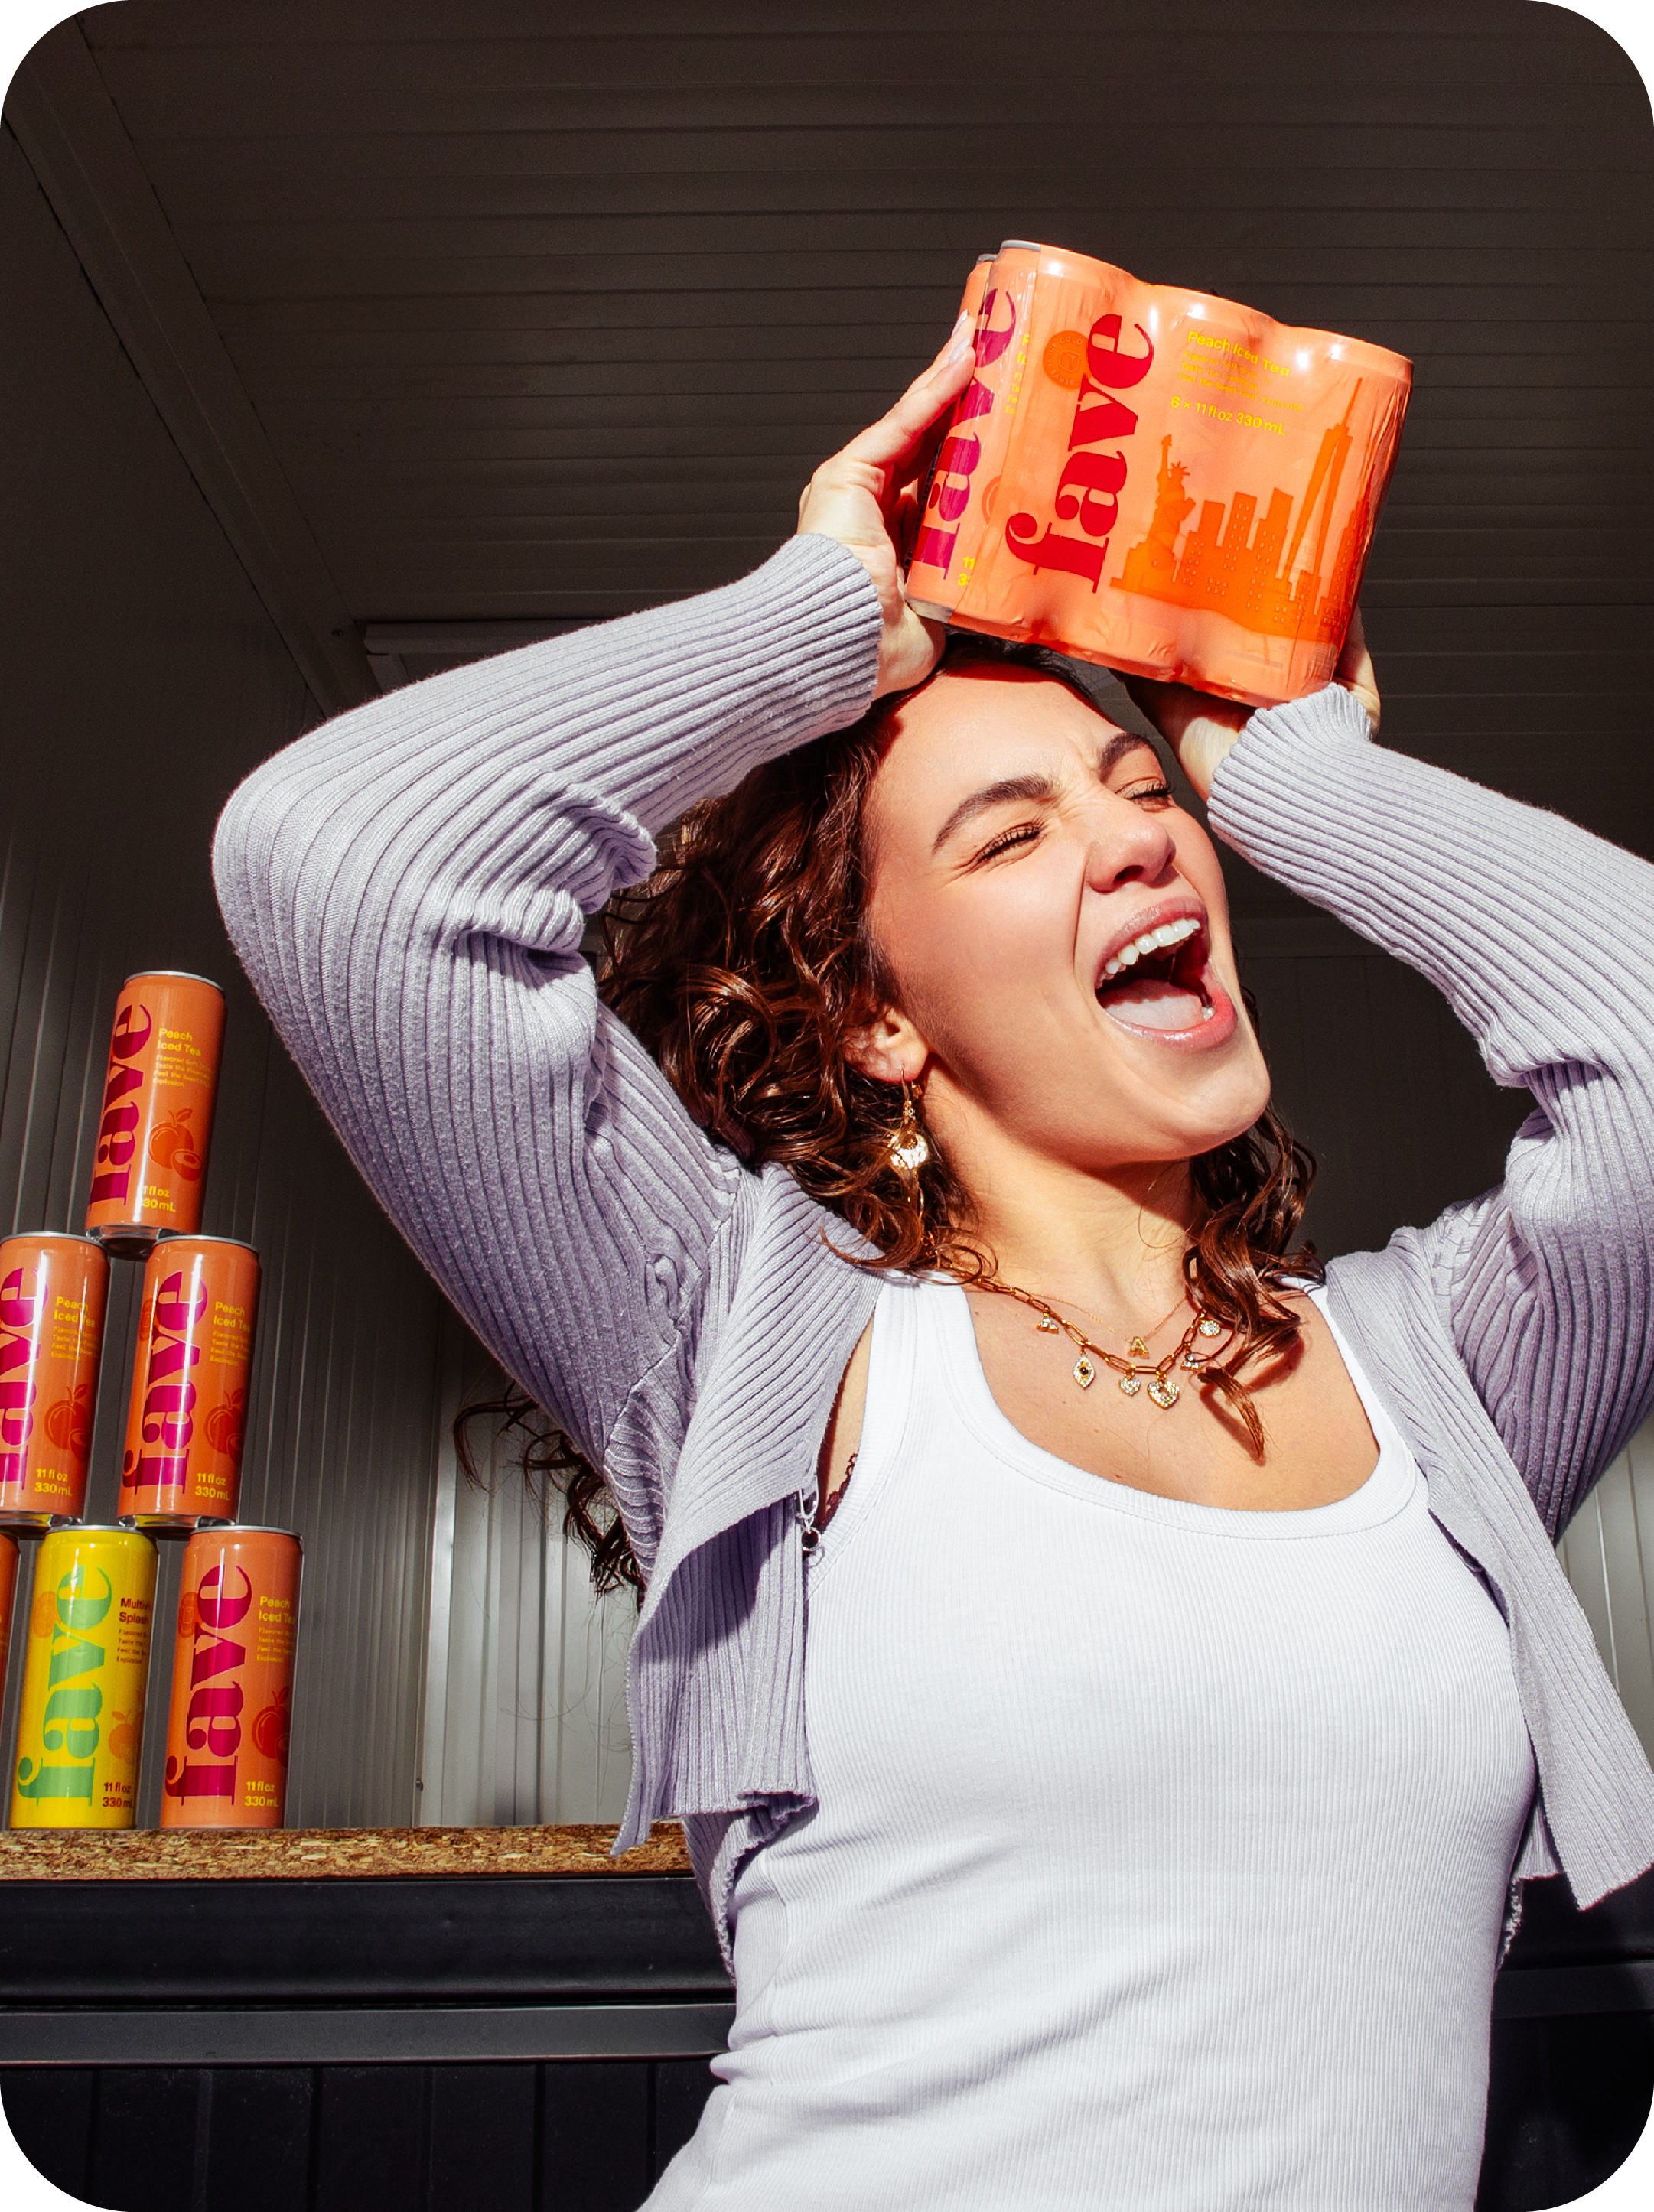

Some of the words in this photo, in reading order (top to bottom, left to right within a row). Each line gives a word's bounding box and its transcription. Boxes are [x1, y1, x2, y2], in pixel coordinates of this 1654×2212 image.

[1187, 331, 1230, 353] Peach
[1233, 343, 1259, 365] Iced
[1263, 359, 1290, 376] Tea
[1170, 395, 1180, 409] 6
[1236, 412, 1262, 428] 330
[1264, 421, 1286, 436] mL
[1005, 314, 1154, 594] fave
[158, 1028, 192, 1041] Peach
[158, 1039, 181, 1052] Iced
[184, 1043, 201, 1056] Tea
[157, 1189, 170, 1198] oz
[159, 1202, 176, 1212] mL
[215, 1301, 245, 1316] Peach
[54, 1309, 78, 1323] Iced
[213, 1314, 236, 1328] Iced
[123, 1270, 208, 1495] fave
[36, 1468, 46, 1478] 11
[57, 1473, 68, 1482] oz
[197, 1472, 207, 1482] 11
[215, 1477, 226, 1486] oz
[34, 1482, 57, 1494] 330
[195, 1485, 216, 1498] 330
[259, 1596, 290, 1609] Peach
[259, 1609, 282, 1622] Iced
[18, 1565, 112, 1807] fave
[165, 1565, 252, 1806] fave
[103, 1782, 113, 1792] 11
[246, 1781, 256, 1791] 11
[103, 1797, 122, 1807] 330
[244, 1795, 265, 1807] 330
